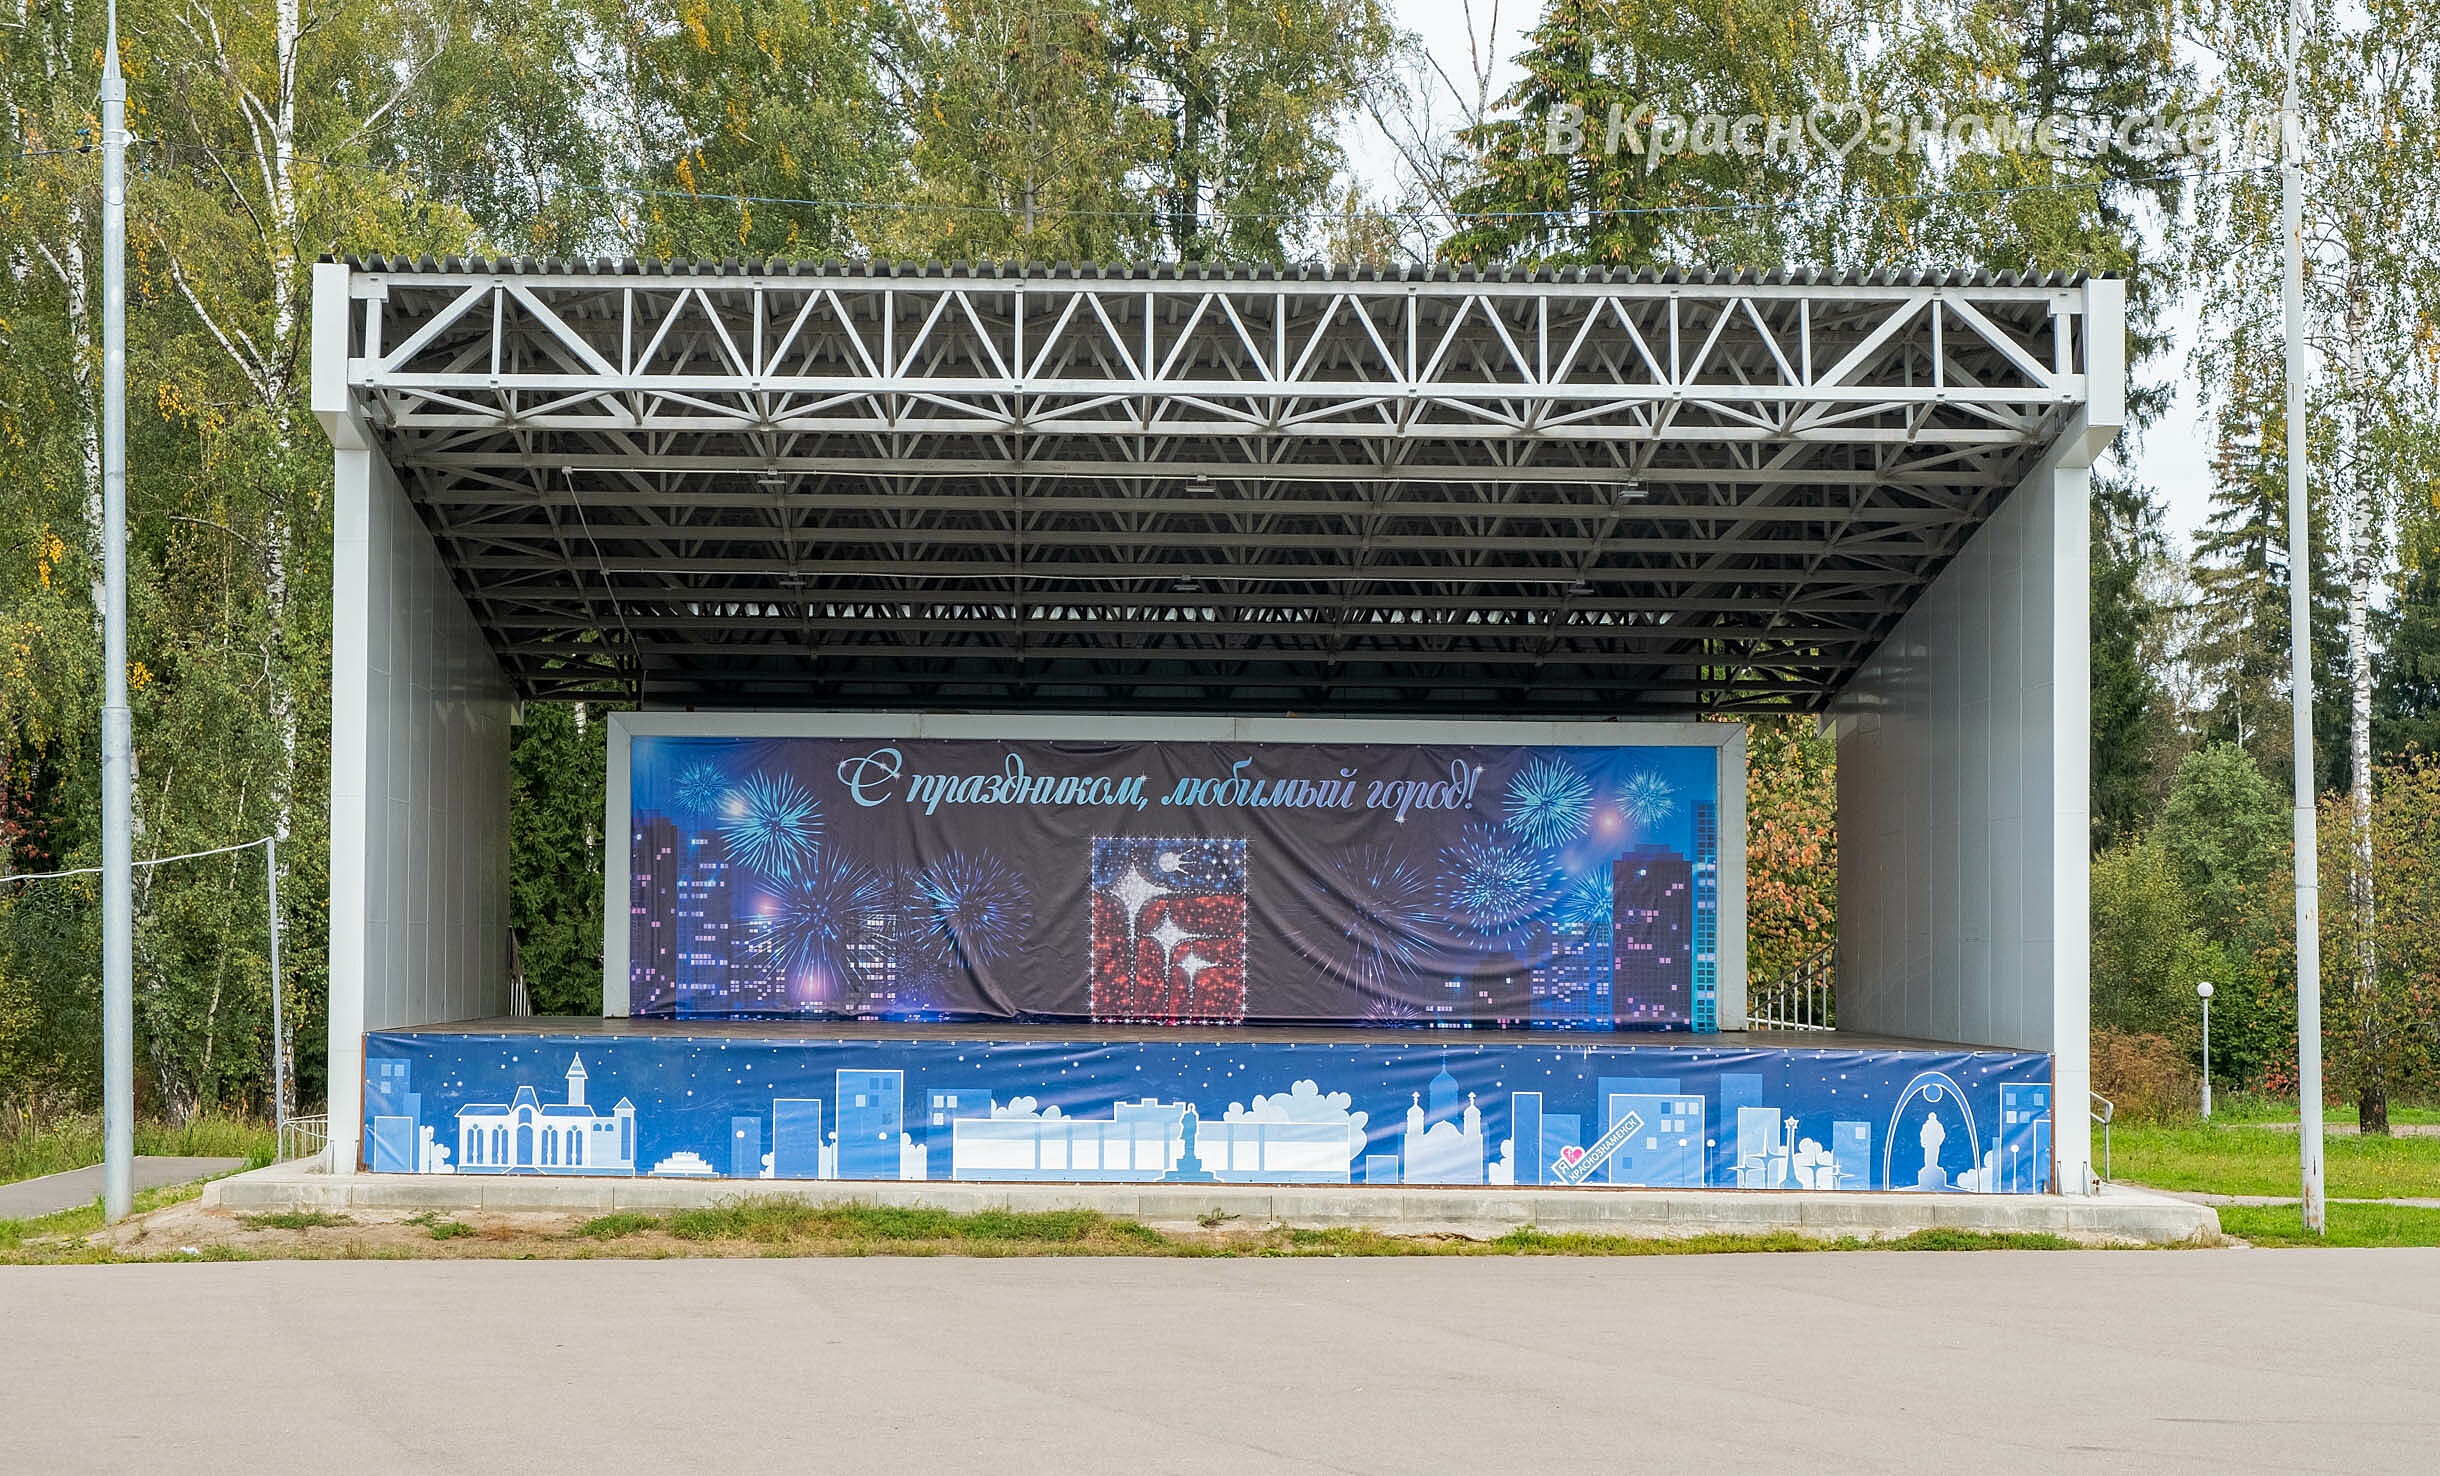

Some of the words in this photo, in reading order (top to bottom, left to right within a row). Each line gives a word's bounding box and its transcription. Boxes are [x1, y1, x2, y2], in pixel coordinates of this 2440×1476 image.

[837, 747, 903, 807] С
[906, 752, 1149, 815] праздником,
[1160, 756, 1359, 808] любимый
[1366, 759, 1482, 822] город!
[1558, 1160, 1570, 1174] Я
[1568, 1118, 1637, 1182] КРАСНОЗНАМЕНСК
